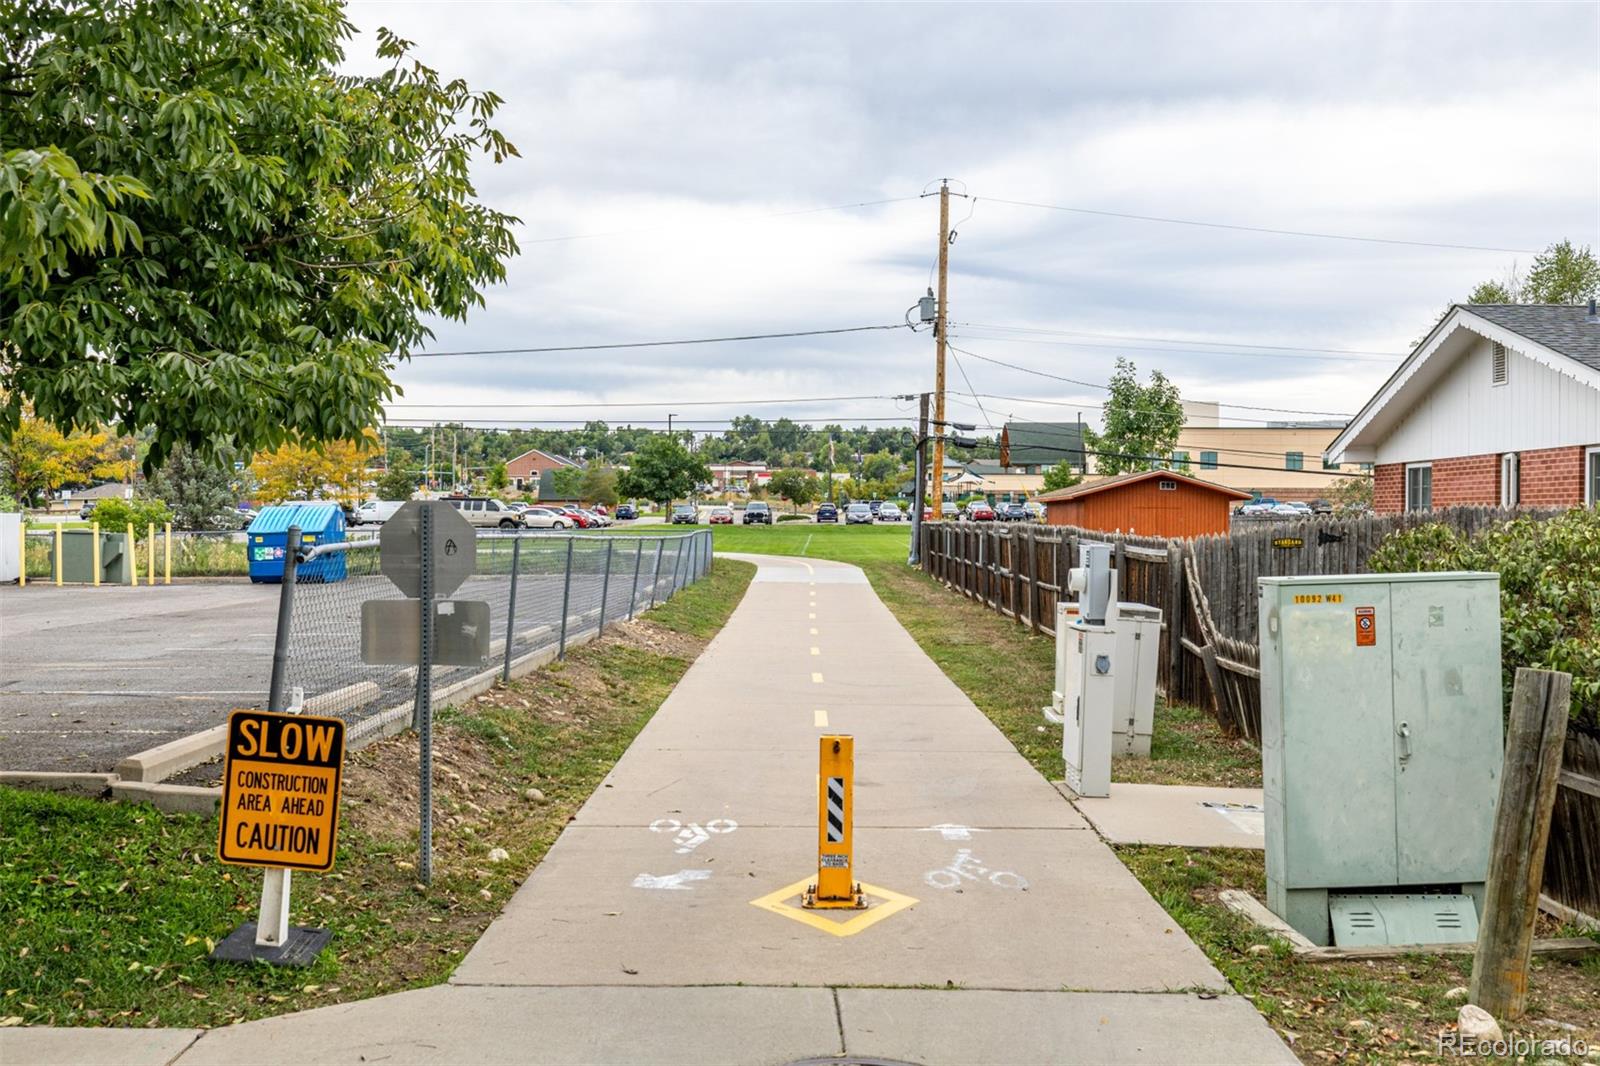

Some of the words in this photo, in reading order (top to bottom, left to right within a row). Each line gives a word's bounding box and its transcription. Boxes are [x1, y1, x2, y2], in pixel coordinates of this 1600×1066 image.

[237, 719, 336, 762] SLOW
[237, 770, 328, 795] CONSTRUCTION
[237, 793, 271, 812] AREA
[281, 797, 324, 817] AHEAD
[236, 821, 320, 855] CAUTION
